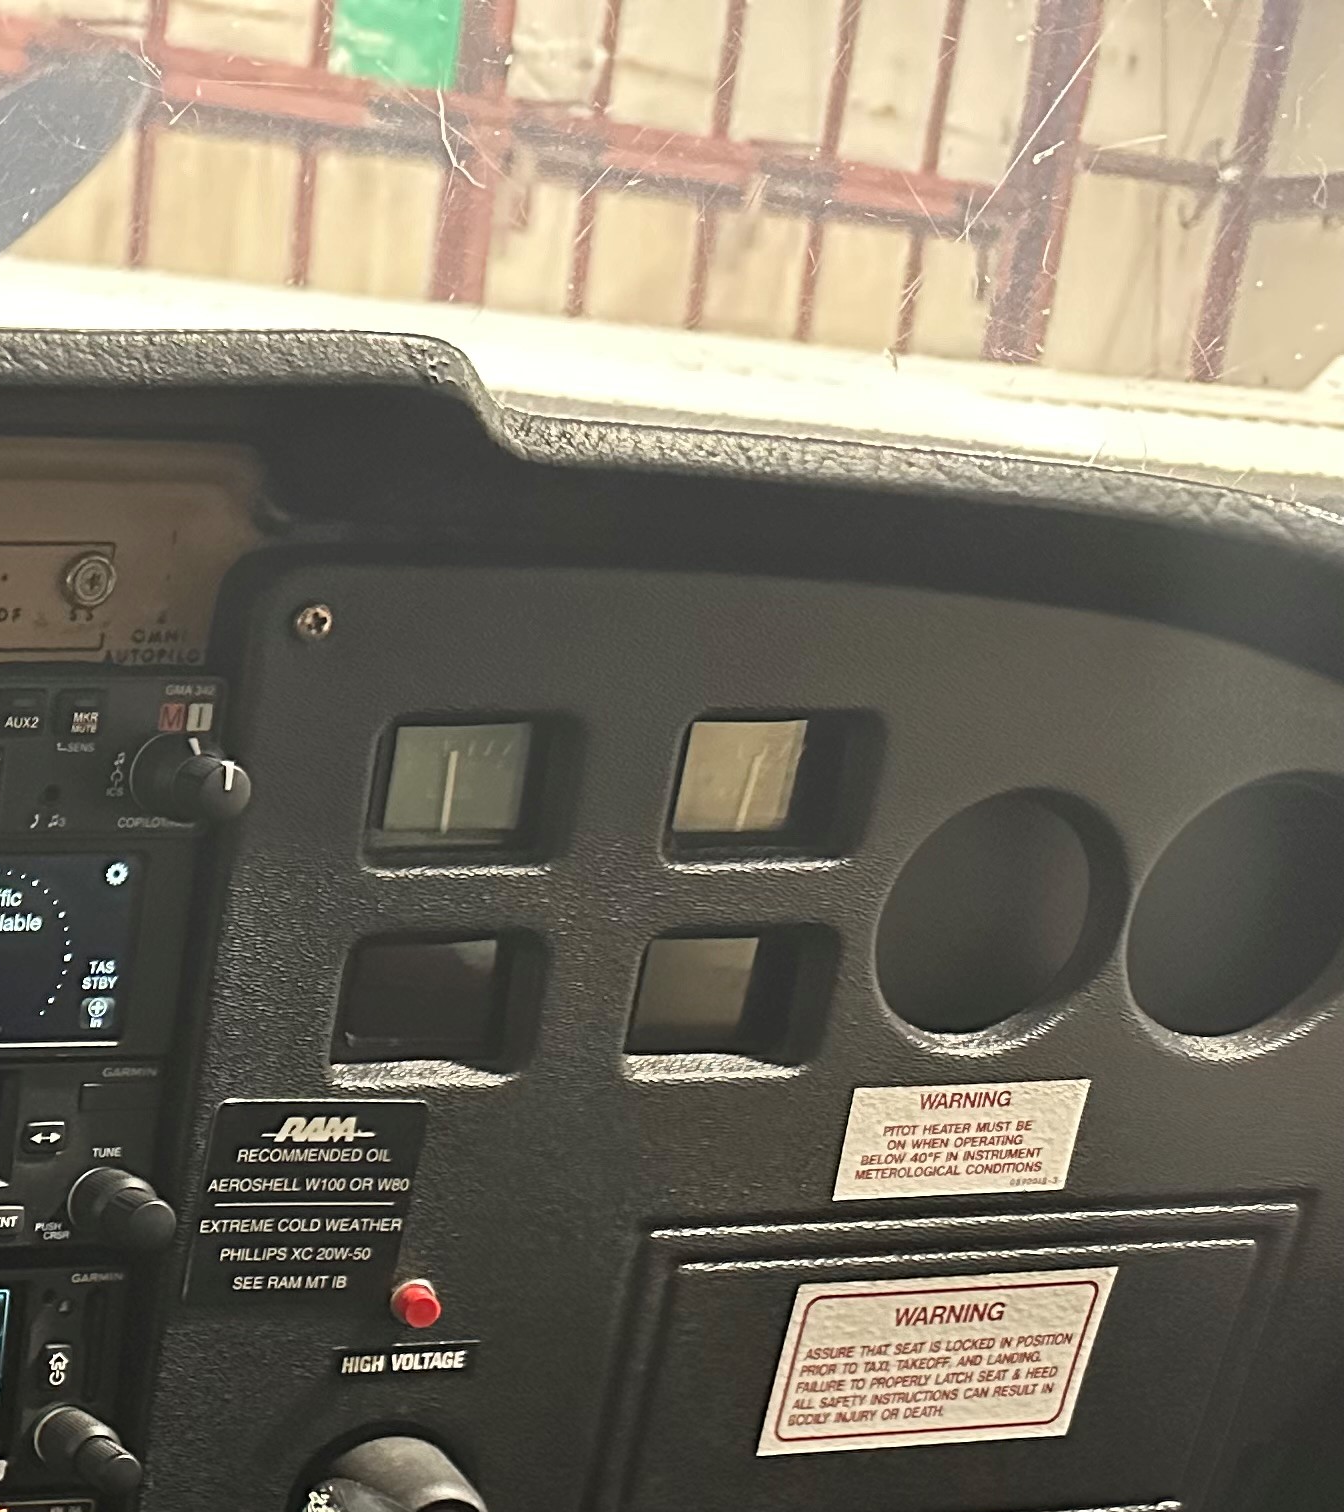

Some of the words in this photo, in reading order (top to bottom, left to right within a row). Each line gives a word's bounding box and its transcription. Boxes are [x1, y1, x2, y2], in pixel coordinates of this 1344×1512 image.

[4, 716, 39, 729] AUX2
[919, 1091, 1012, 1110] WARNING
[273, 1116, 358, 1142] RAM
[883, 1125, 918, 1137] PITOT
[923, 1123, 971, 1135] HEATER
[976, 1121, 1011, 1132] MUST
[1016, 1120, 1032, 1131] BE
[887, 1139, 908, 1150] ON
[912, 1138, 949, 1149] WHEN
[954, 1135, 1023, 1147] OPERATING
[92, 1147, 122, 1158] TUNE
[237, 1148, 362, 1163] RECOMMENDED
[366, 1148, 391, 1162] OIL
[861, 1153, 906, 1165] BELOW
[946, 1151, 958, 1162] IN
[963, 1148, 1042, 1161] INSTRUMENT
[855, 1166, 960, 1180] METEROLOGICAL
[965, 1162, 1042, 1176] CONDITIONS
[207, 1177, 301, 1192] AEROSHELL
[305, 1177, 345, 1191] W100
[349, 1177, 373, 1191] OR
[377, 1177, 410, 1191] W80
[199, 1219, 274, 1234] EXTREME
[277, 1219, 320, 1232] COLD
[324, 1218, 403, 1232] WEATHER
[219, 1248, 287, 1262] PHILLIPS
[290, 1248, 312, 1260] XC
[316, 1247, 371, 1260] 20W-50
[232, 1276, 264, 1290] SEE
[267, 1276, 302, 1290] RAM
[305, 1276, 329, 1289] MT
[894, 1301, 1007, 1327] WARNING
[341, 1356, 384, 1374] HIGH
[390, 1350, 468, 1372] VOLTAGE
